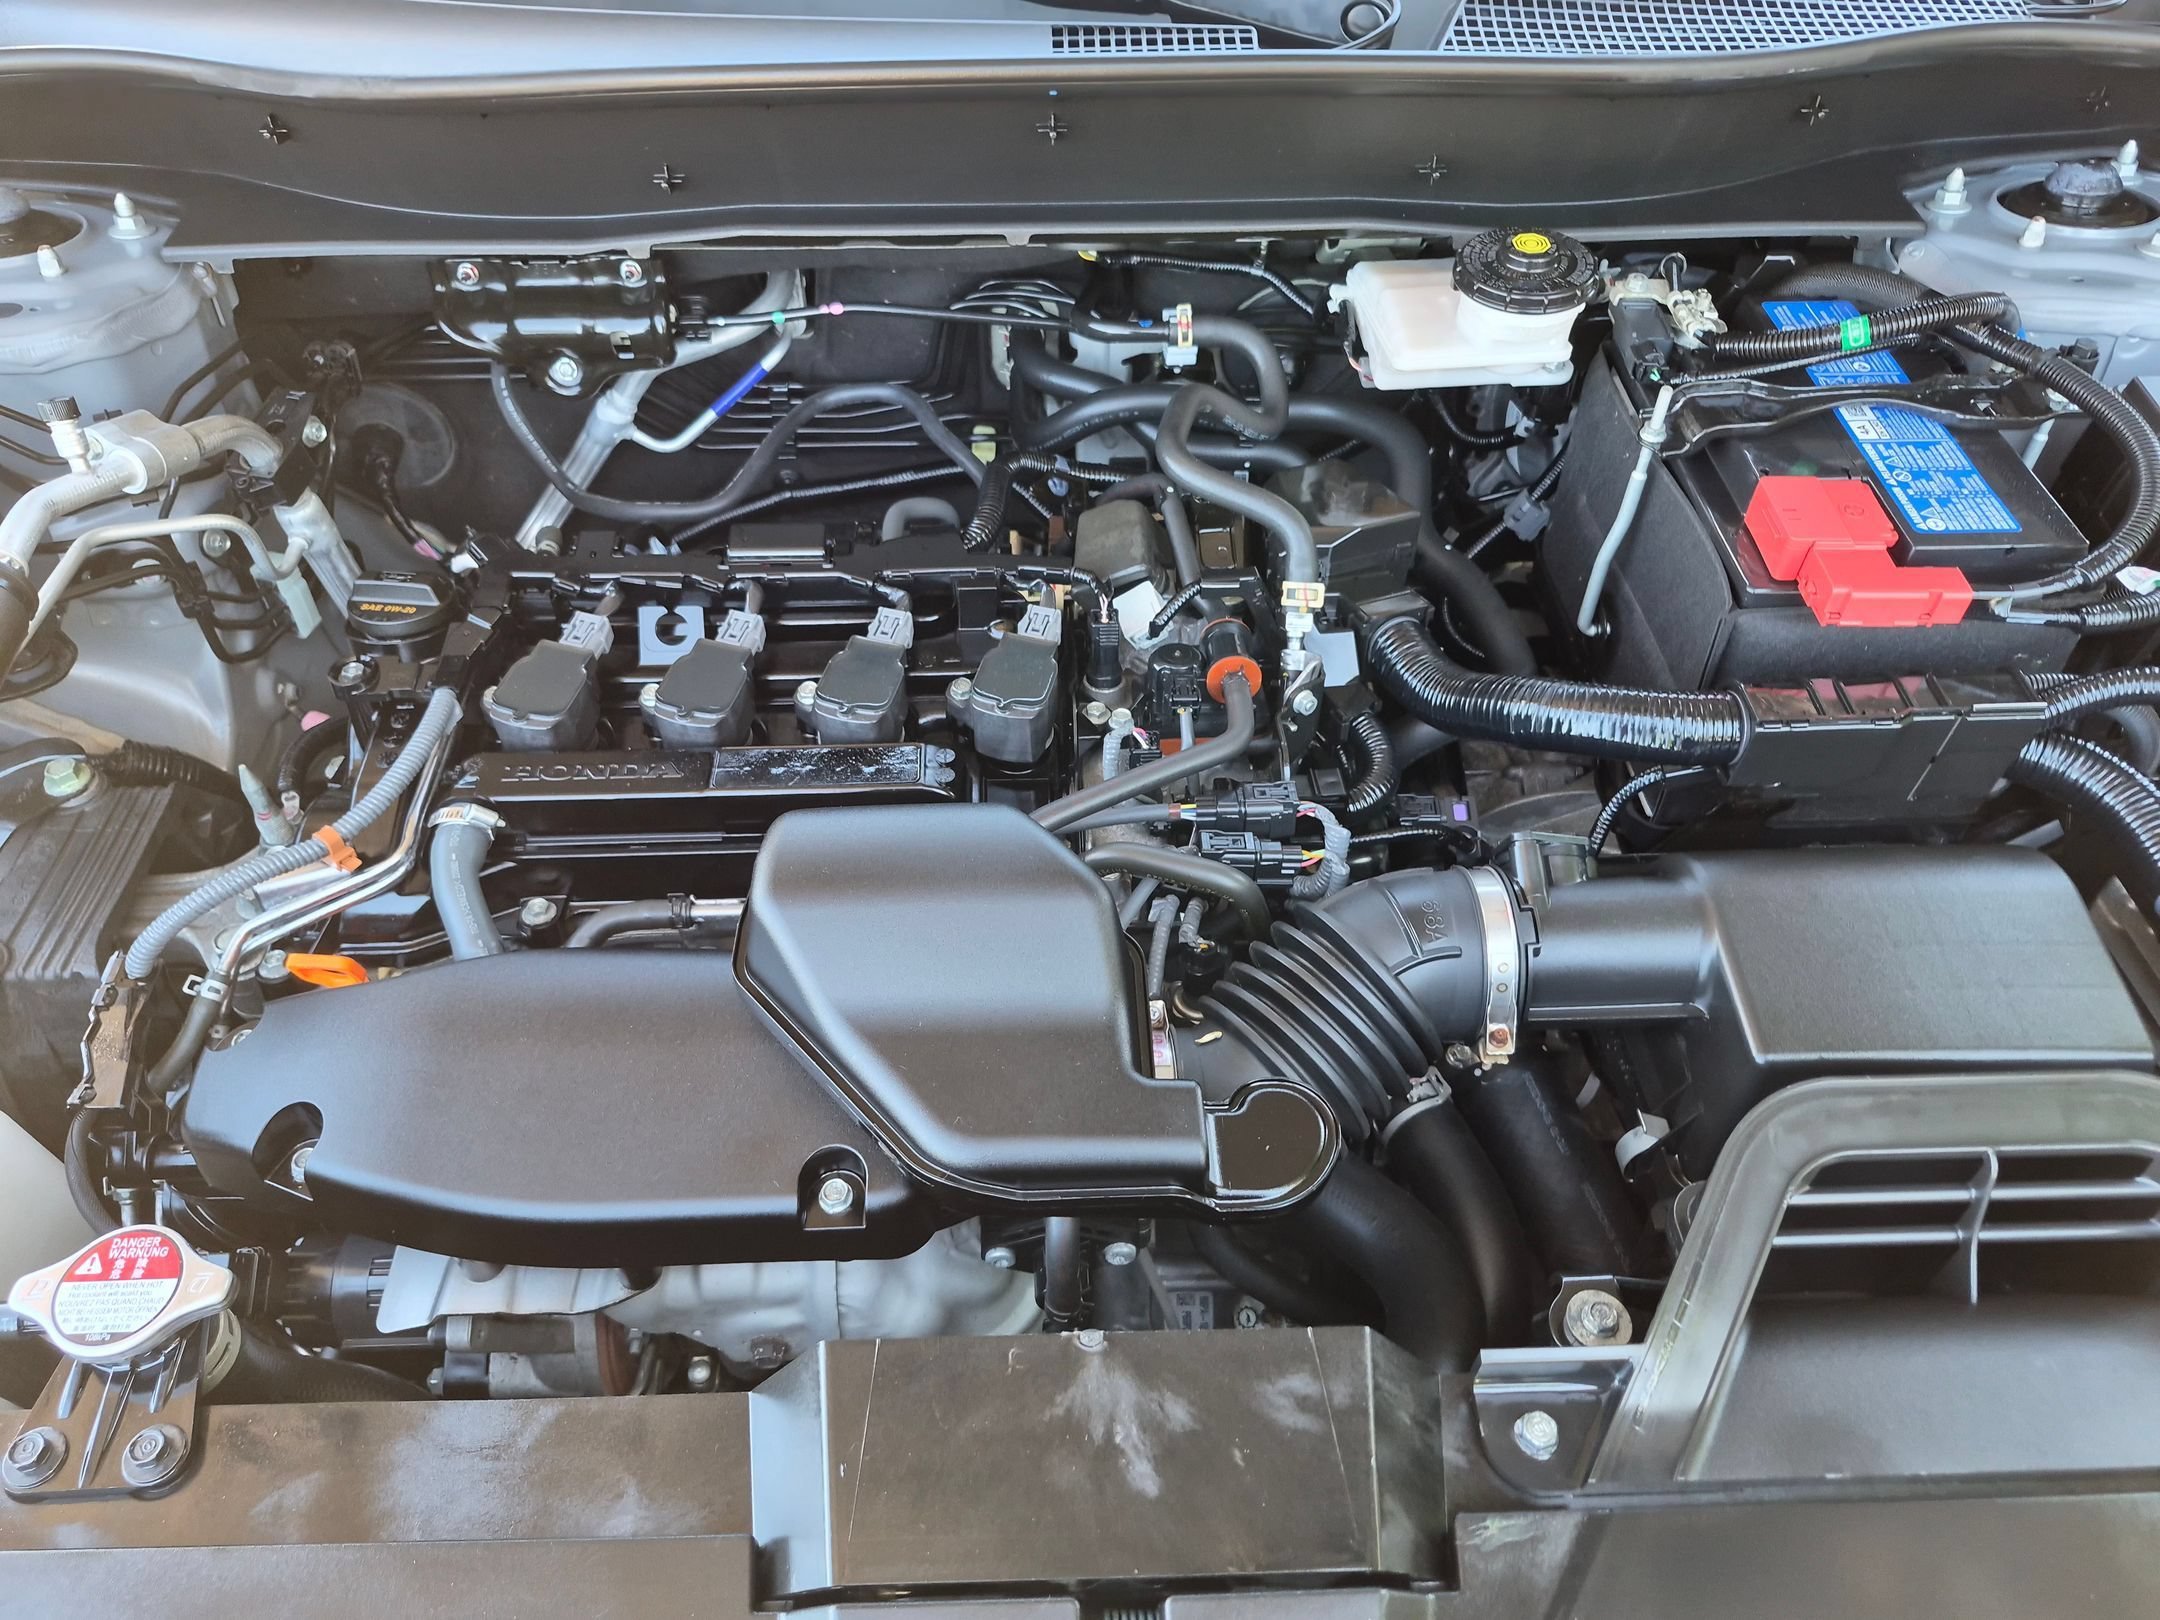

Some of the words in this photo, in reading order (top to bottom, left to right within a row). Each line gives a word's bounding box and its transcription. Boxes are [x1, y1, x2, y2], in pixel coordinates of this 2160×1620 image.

[360, 603, 384, 612] SAE
[384, 605, 417, 614] 0W-20
[500, 761, 685, 782] HONDA
[111, 1236, 162, 1249] DANGER
[108, 1246, 169, 1259] WARNUNG
[71, 1283, 97, 1291] NEVER
[99, 1282, 120, 1290] OPEN
[95, 1298, 110, 1306] PAS
